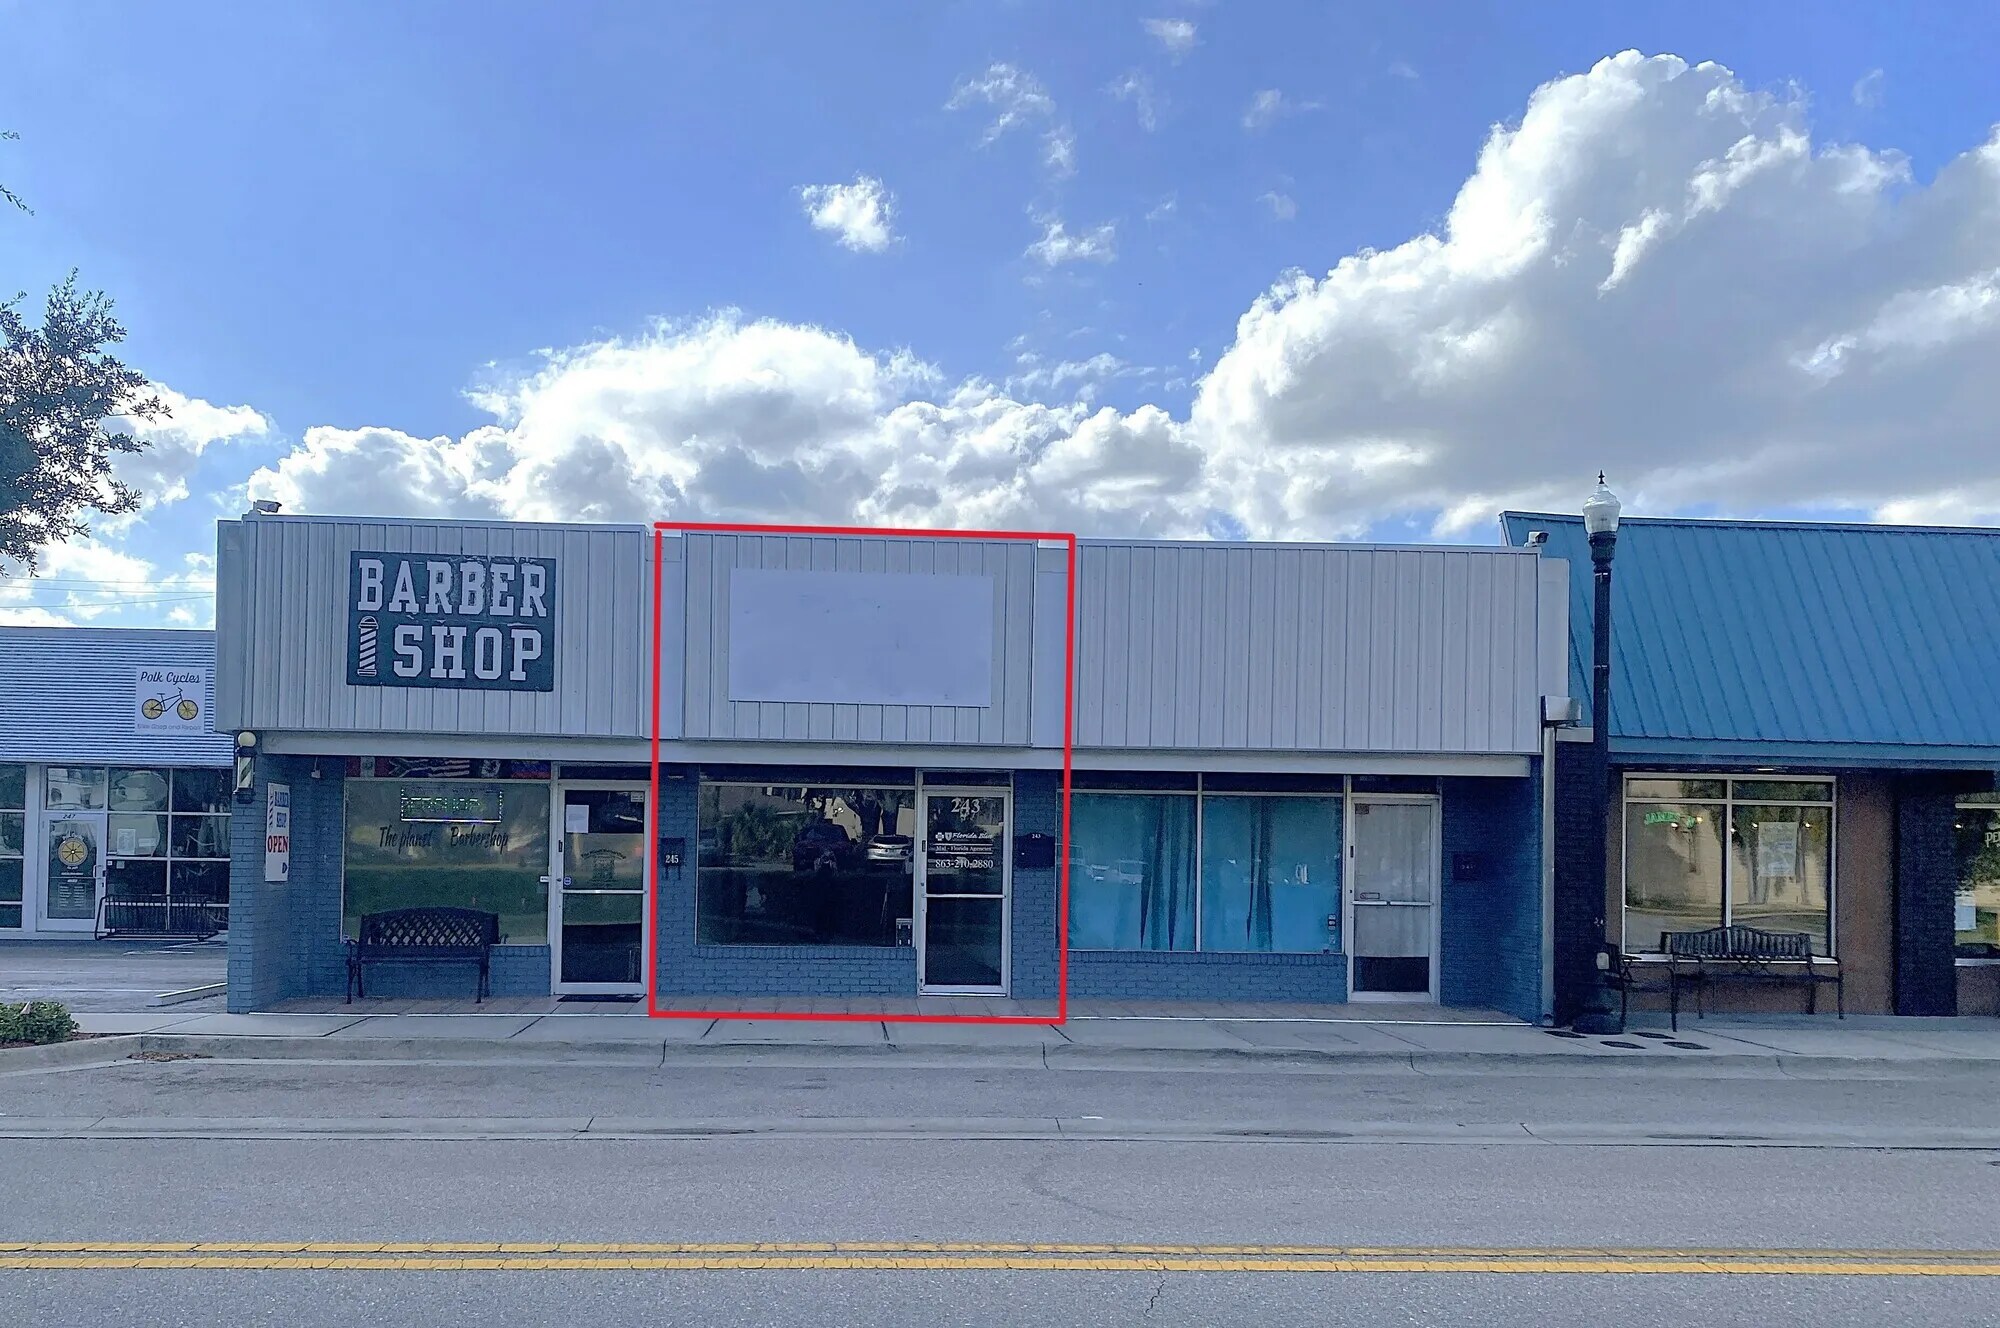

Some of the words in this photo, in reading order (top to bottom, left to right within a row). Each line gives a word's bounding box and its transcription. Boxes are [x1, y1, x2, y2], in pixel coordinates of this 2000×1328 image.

[357, 558, 547, 617] BARBER
[393, 624, 542, 681] SHOP
[140, 671, 163, 683] Polk
[166, 672, 201, 686] Cycles
[951, 798, 980, 814] 243
[267, 835, 289, 853] OPEN
[379, 824, 397, 848] The
[450, 824, 509, 855] Barbershop
[665, 854, 679, 864] 245
[935, 859, 994, 869] 863-210-2880
